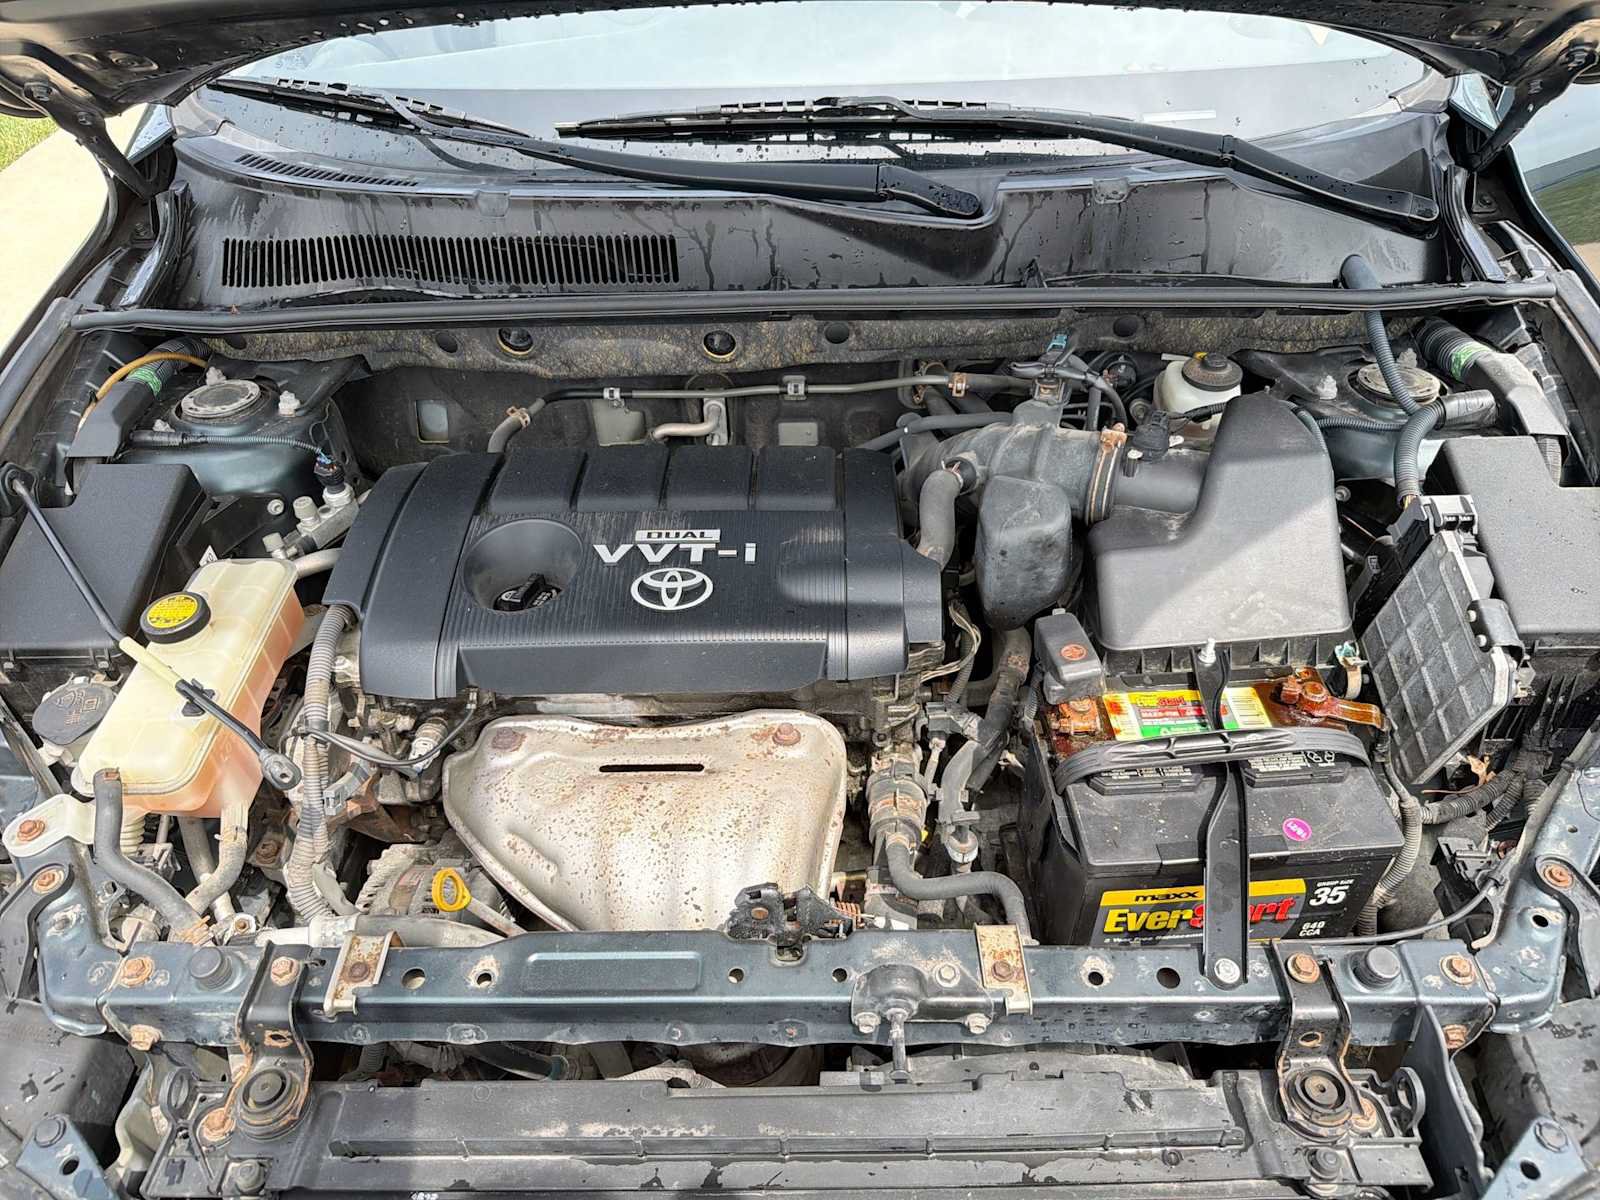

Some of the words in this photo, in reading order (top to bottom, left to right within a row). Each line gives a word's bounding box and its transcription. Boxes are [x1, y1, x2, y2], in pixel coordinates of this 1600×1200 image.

[646, 531, 714, 539] DUAL
[593, 542, 757, 565] VVT-i
[1316, 879, 1339, 887] GROUP
[1134, 890, 1199, 902] maxx
[1309, 885, 1350, 906] 35
[1302, 920, 1325, 930] 640
[1299, 928, 1321, 937] CCA
